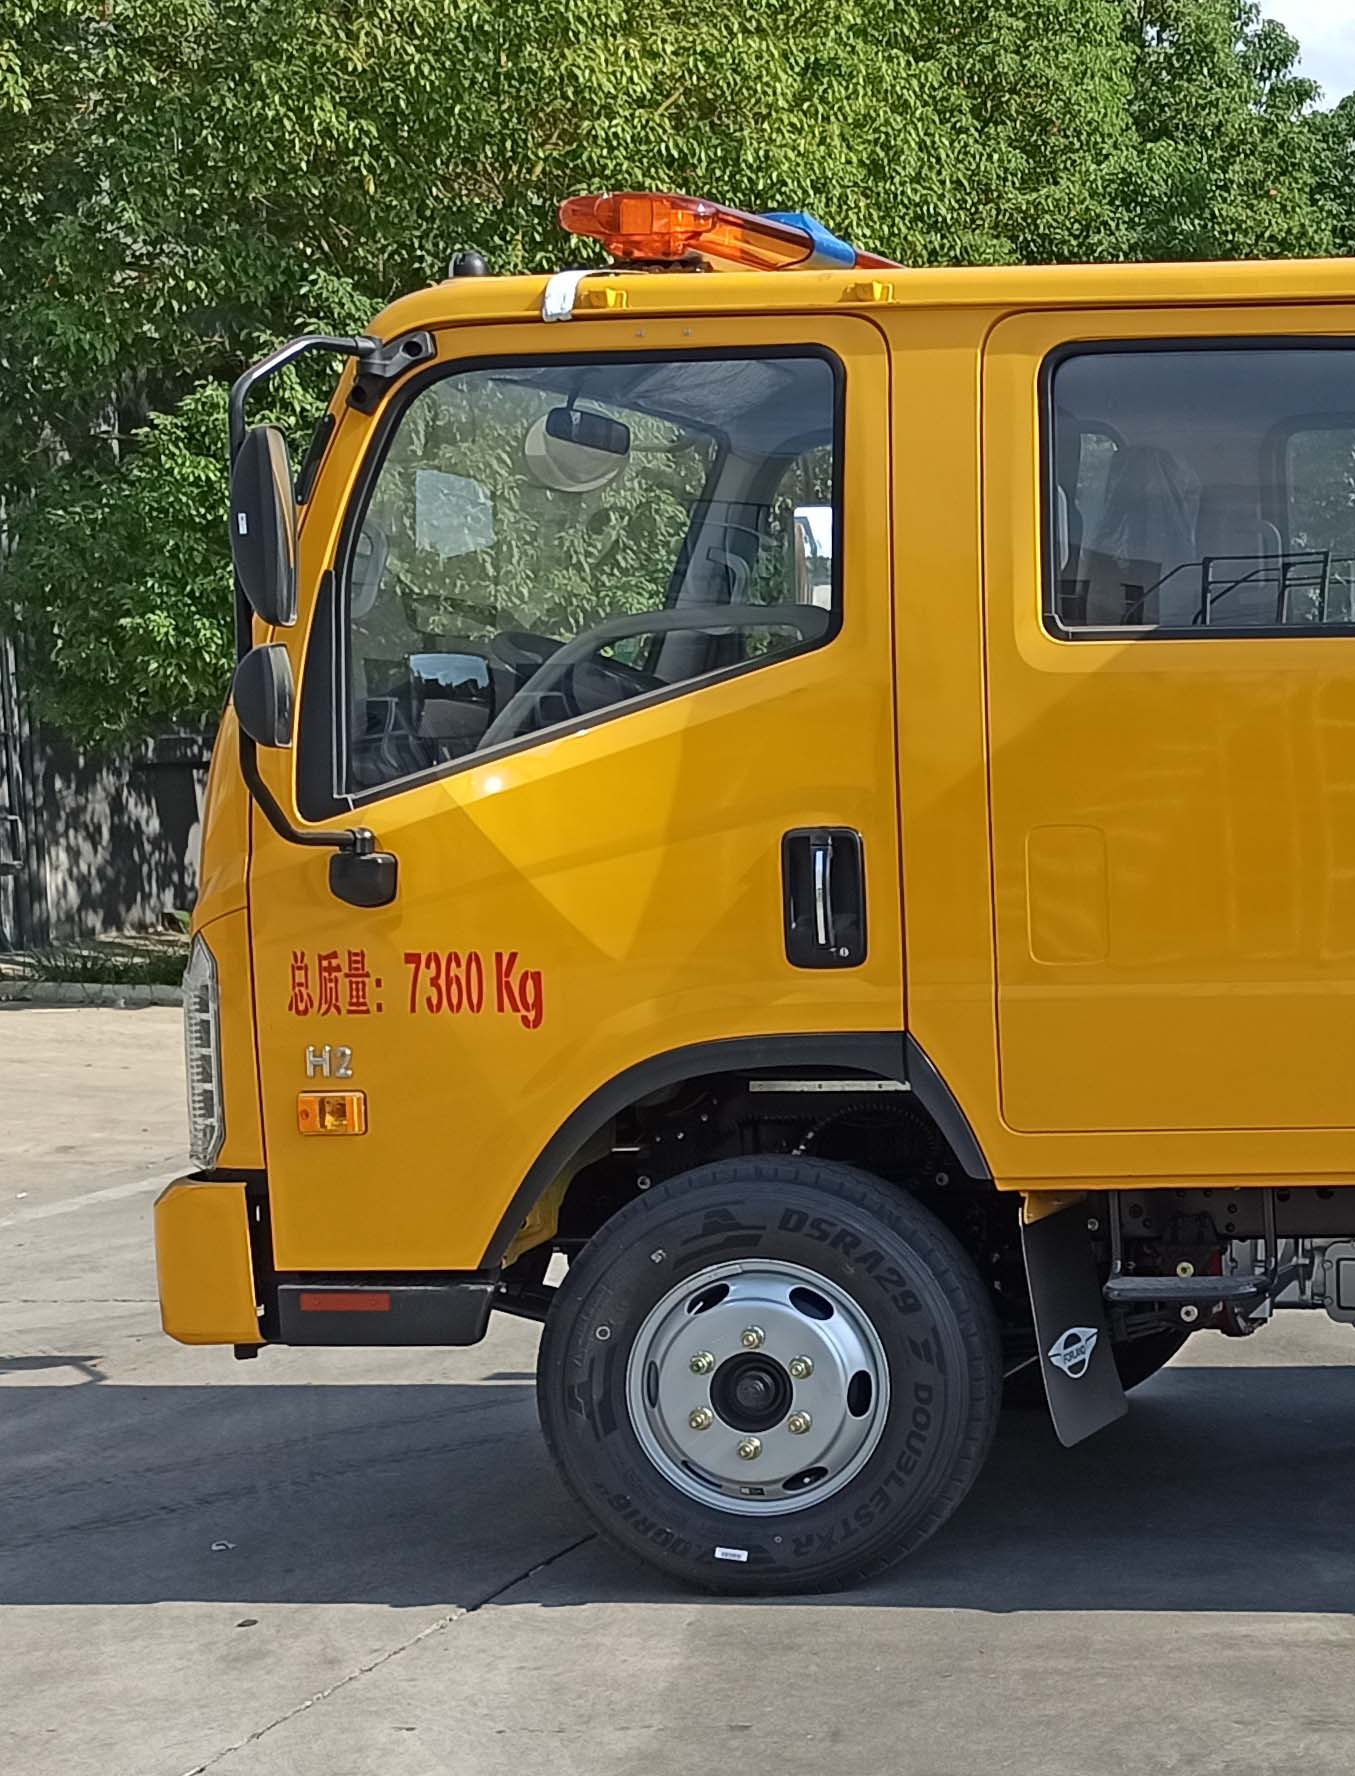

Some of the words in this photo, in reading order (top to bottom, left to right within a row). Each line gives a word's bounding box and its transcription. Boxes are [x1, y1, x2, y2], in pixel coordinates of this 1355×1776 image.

[404, 951, 484, 1015] 7360
[495, 951, 544, 1030] Kg
[306, 1045, 353, 1079] H2
